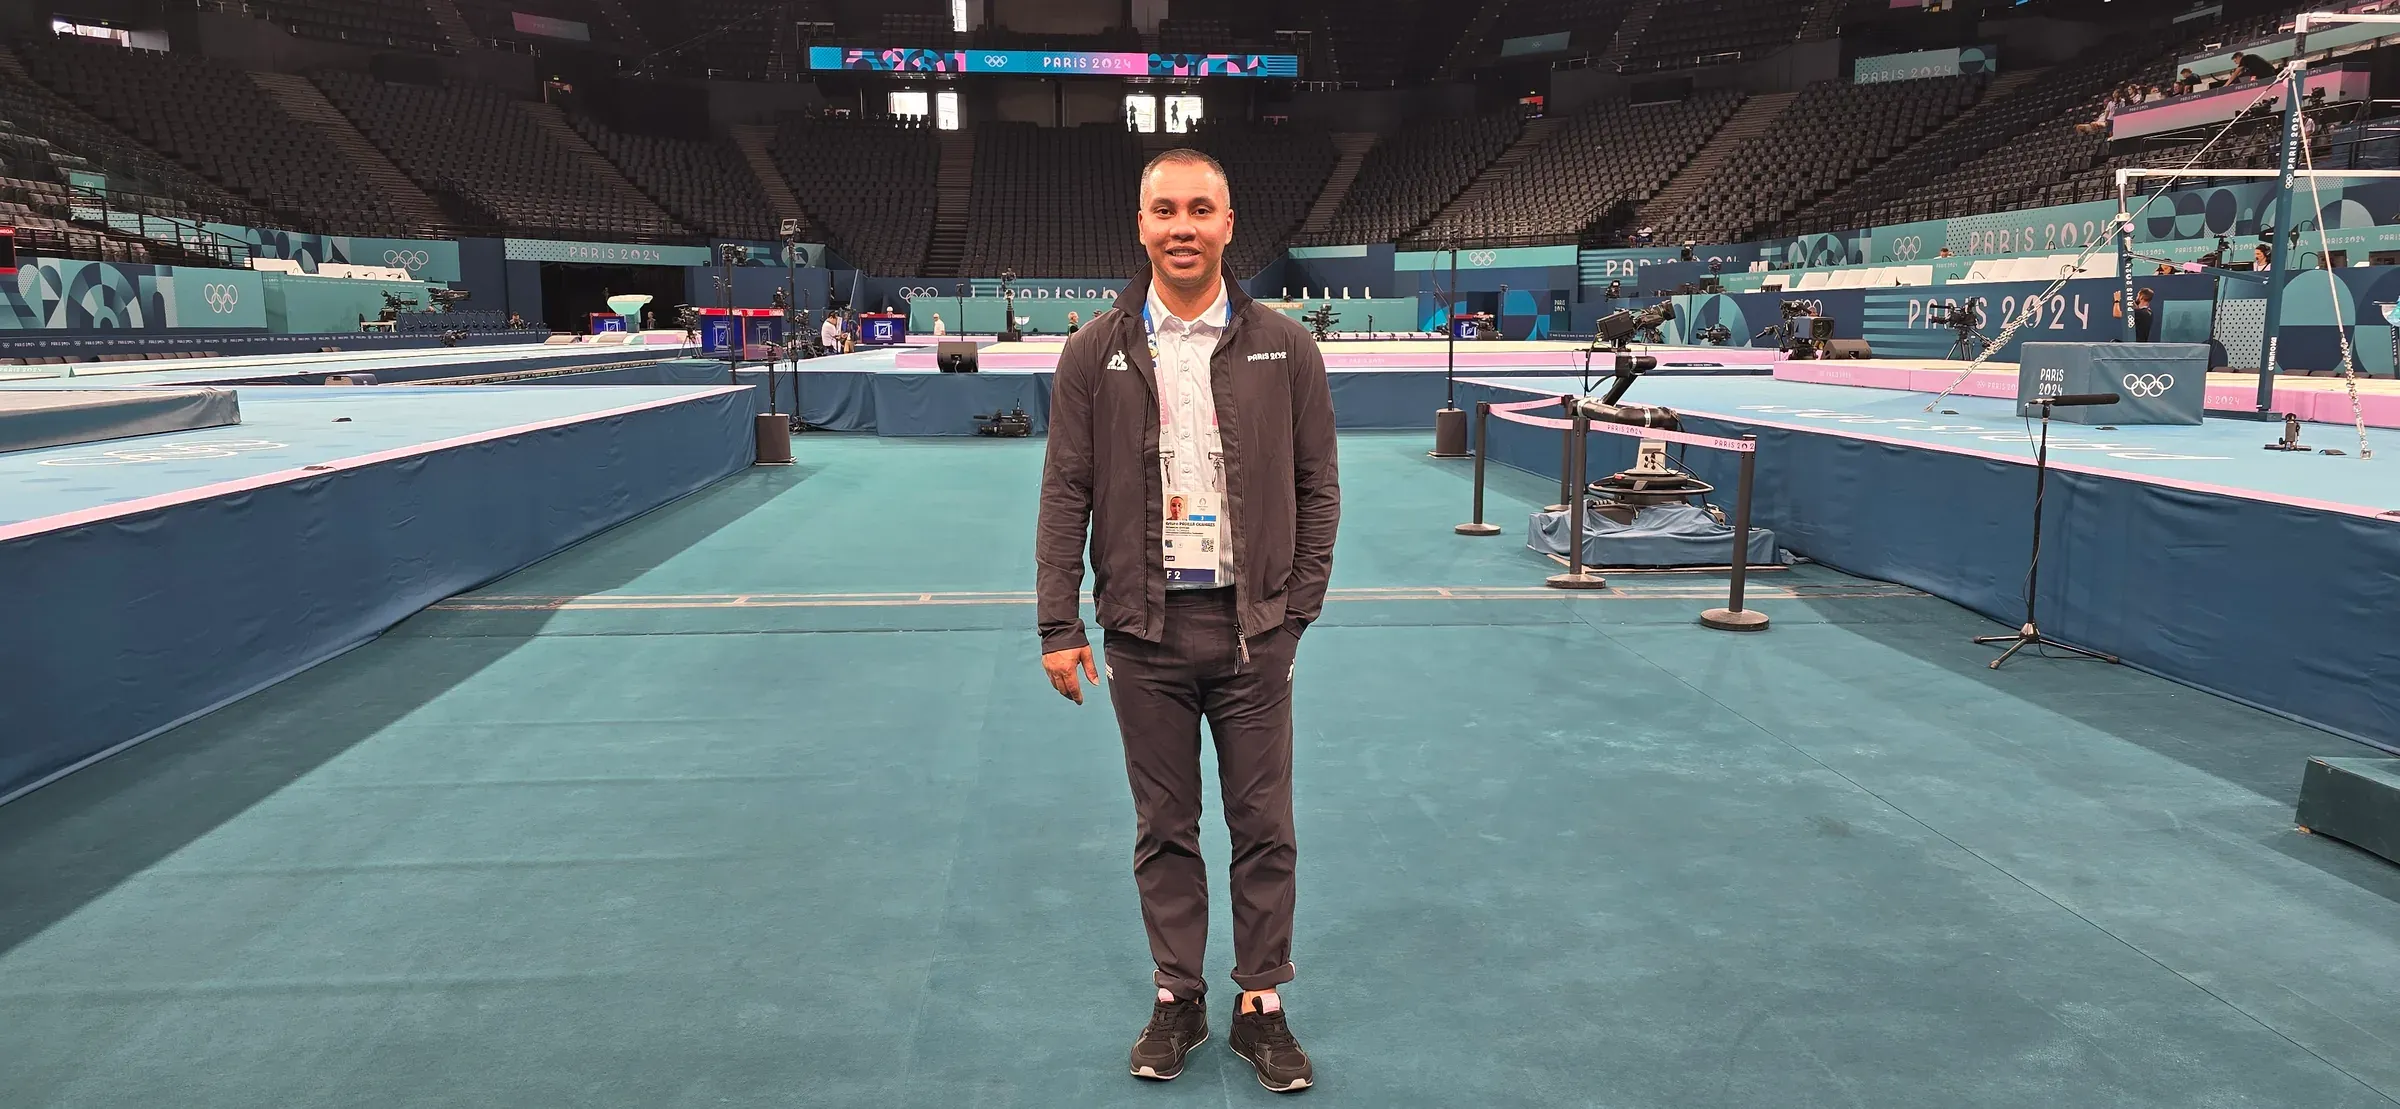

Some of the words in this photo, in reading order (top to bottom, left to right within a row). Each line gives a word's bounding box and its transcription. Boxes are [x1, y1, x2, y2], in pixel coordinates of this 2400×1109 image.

[1092, 58, 1131, 68] 2024
[1911, 65, 1952, 77] 2024
[569, 246, 615, 260] PARIS
[620, 248, 660, 261] 2024
[1270, 351, 1287, 360] 202
[2038, 383, 2063, 396] 2024
[1737, 442, 1755, 450] 202
[1166, 570, 1172, 580] F
[1174, 570, 1181, 580] 2
